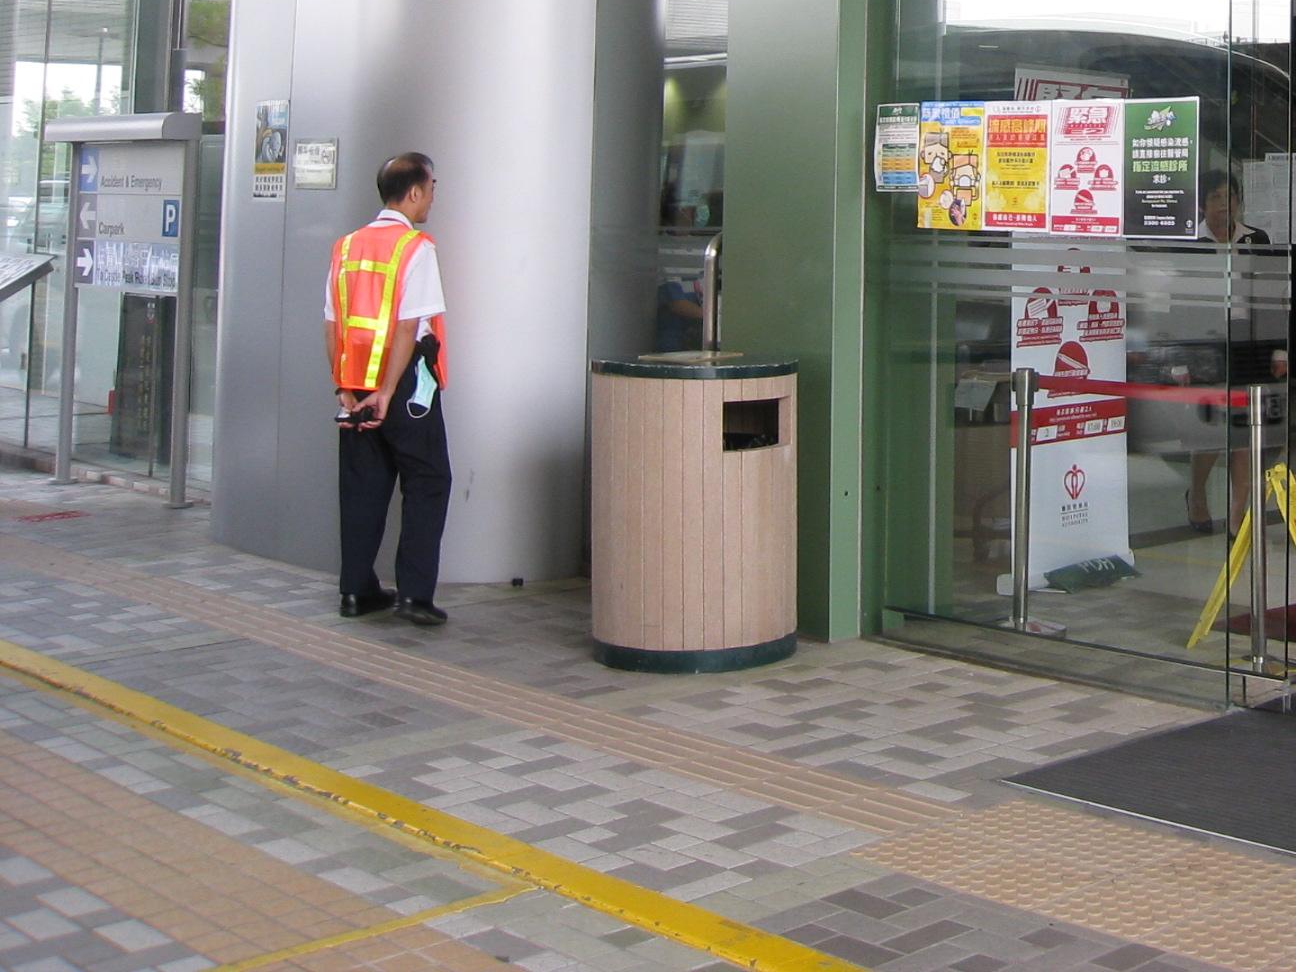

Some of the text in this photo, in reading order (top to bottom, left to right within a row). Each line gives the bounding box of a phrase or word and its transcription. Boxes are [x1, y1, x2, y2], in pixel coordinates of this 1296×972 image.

[1067, 107, 1108, 124] 緊急
[101, 175, 125, 189] Accident
[131, 176, 163, 192] Emergency
[166, 204, 177, 233] P
[98, 222, 124, 237] Carpark
